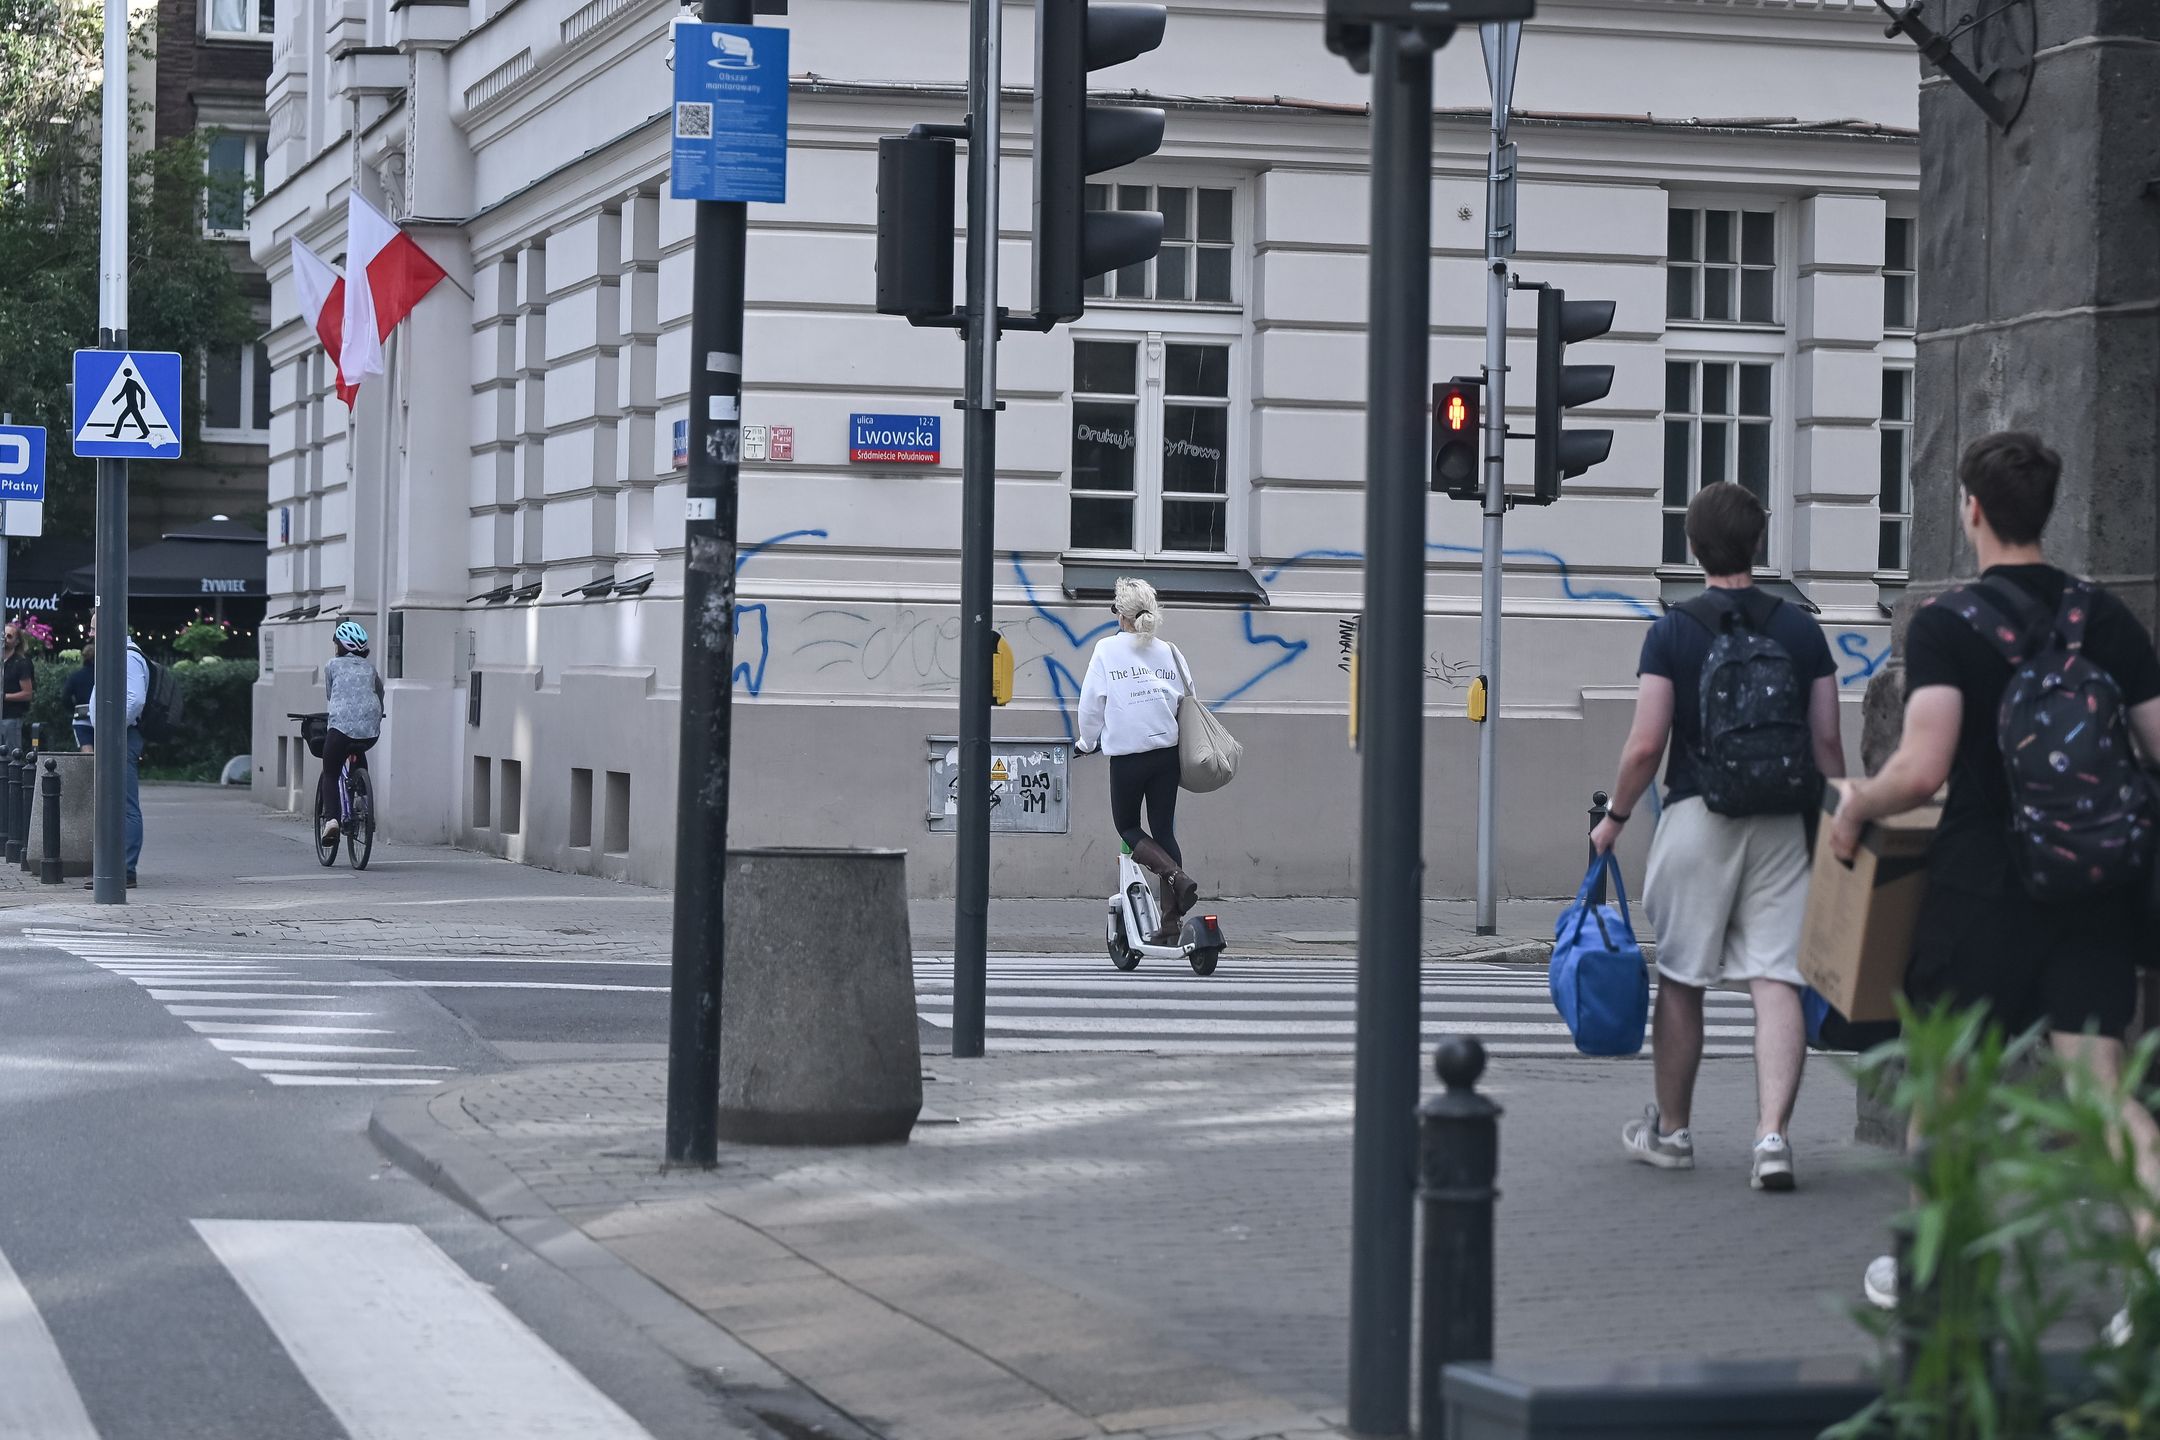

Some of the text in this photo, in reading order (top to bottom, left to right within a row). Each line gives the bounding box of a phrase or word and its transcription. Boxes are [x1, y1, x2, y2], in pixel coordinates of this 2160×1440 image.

[719, 72, 747, 81] Obszar
[705, 82, 760, 94] monitorowany
[856, 415, 874, 425] ulica
[857, 426, 934, 447] Lwowska
[857, 449, 934, 462] Śródmieście Południowe
[1, 479, 39, 495] Płatny
[200, 577, 246, 593] ŻYWIEC
[1109, 669, 1129, 681] The
[1155, 668, 1176, 681] Club
[1021, 772, 1051, 790] DAJ
